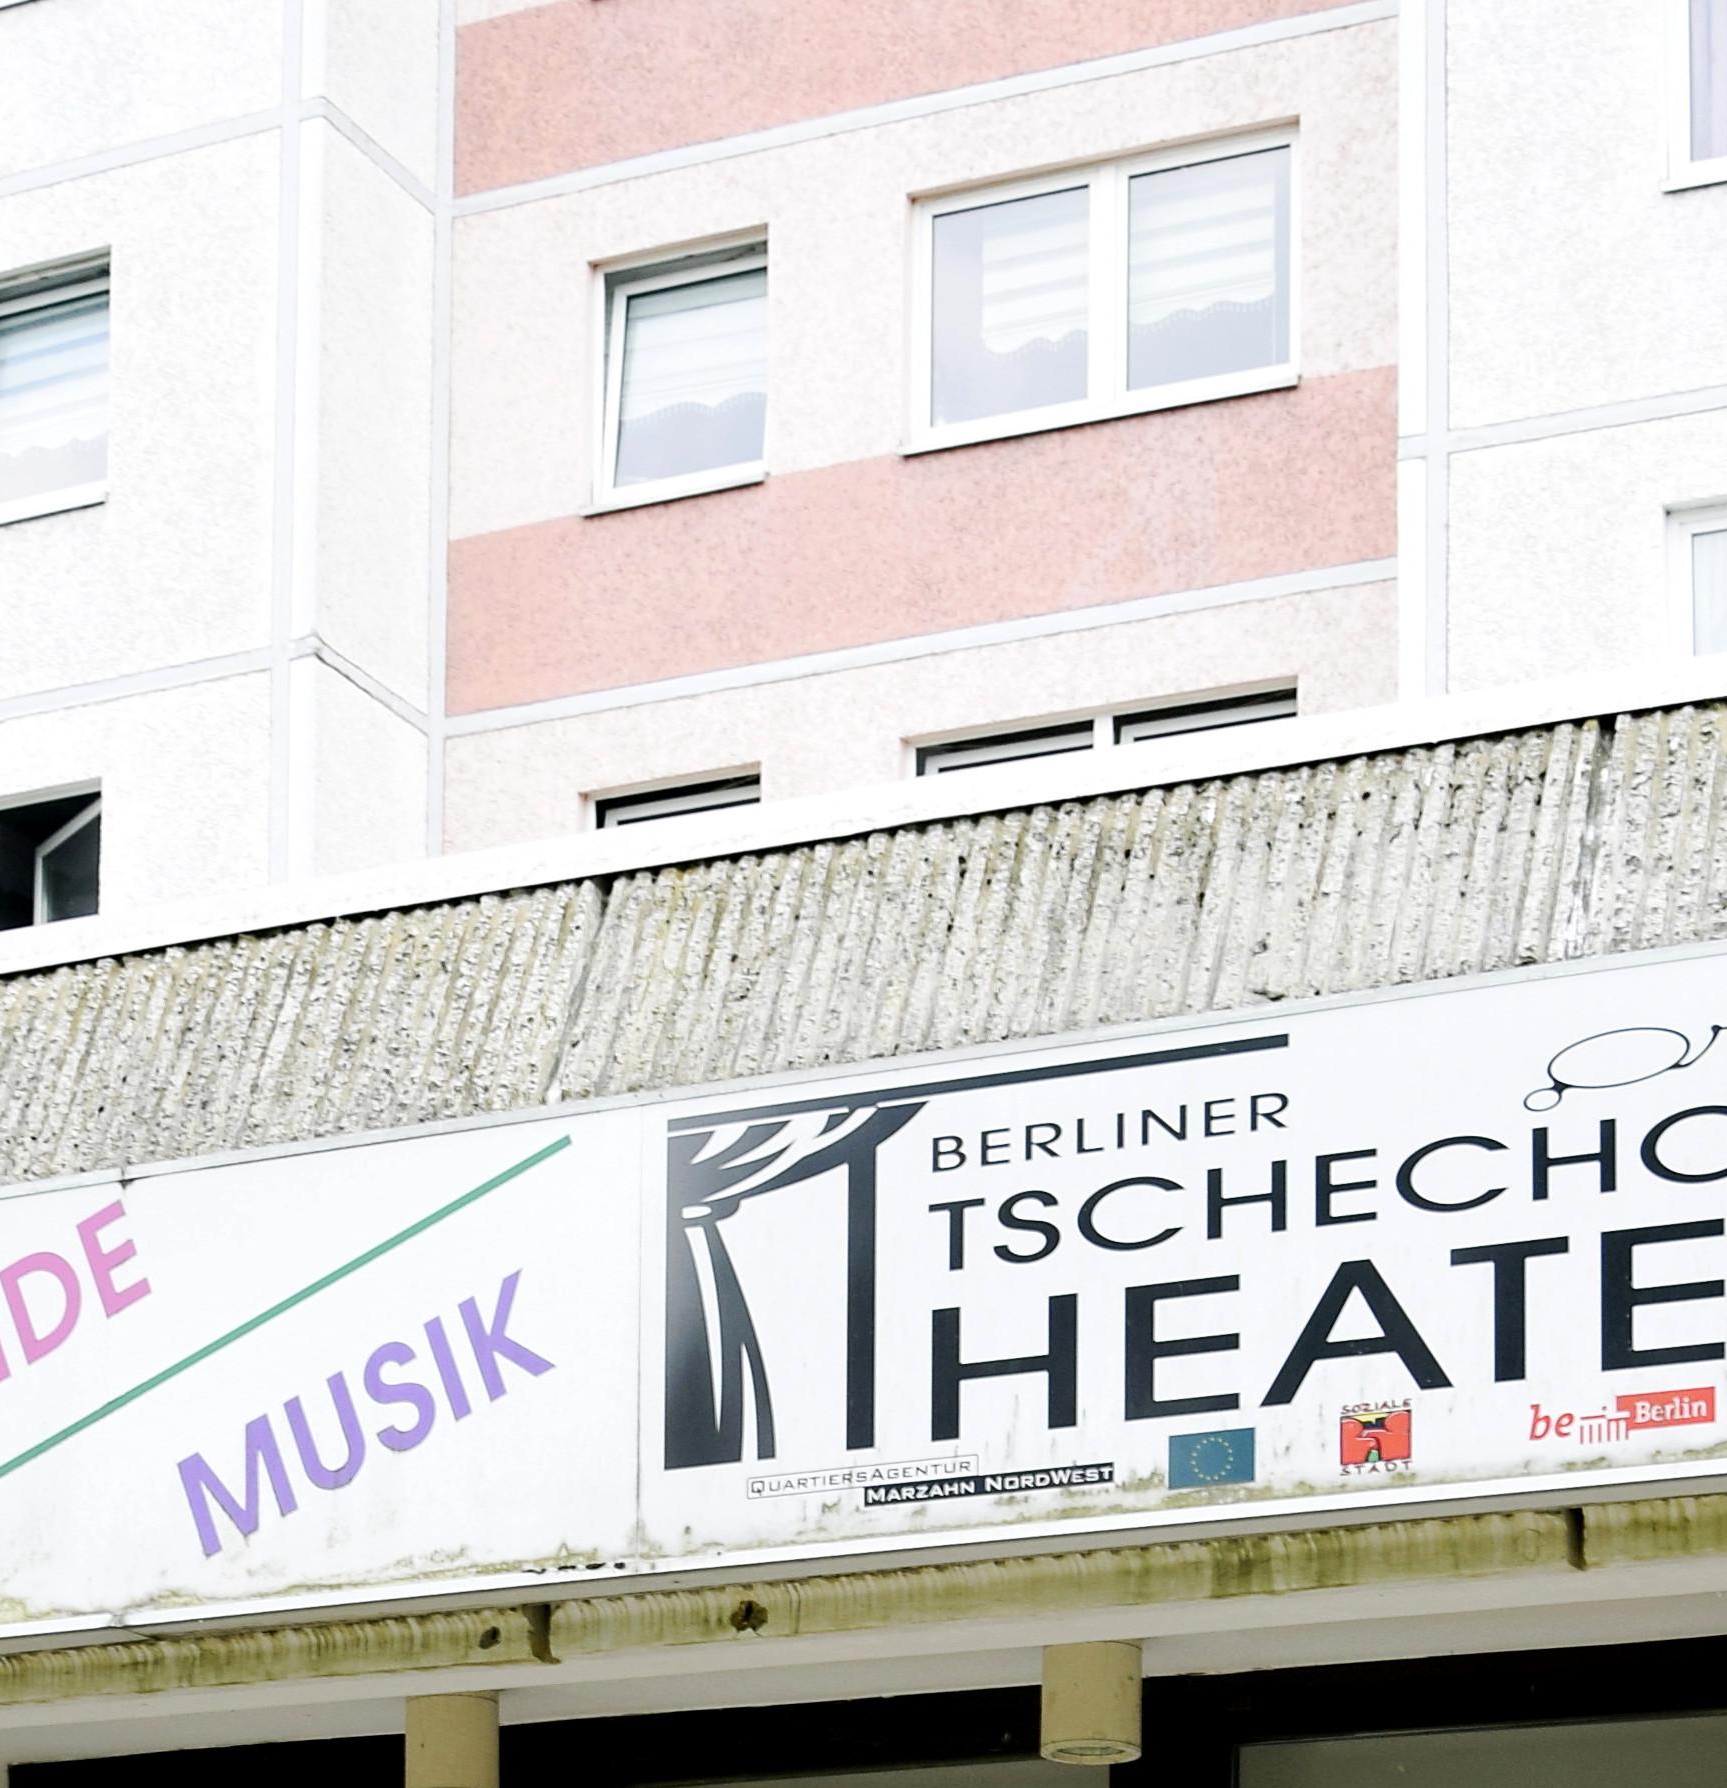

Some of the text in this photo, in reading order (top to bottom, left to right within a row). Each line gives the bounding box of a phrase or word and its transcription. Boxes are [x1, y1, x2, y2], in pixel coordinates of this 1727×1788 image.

[932, 1091, 1289, 1174] BERLINER
[175, 1267, 557, 1558] MUSIK
[1339, 1397, 1412, 1415] SOZIALE
[1634, 1395, 1708, 1424] Berlin
[1338, 1460, 1412, 1477] STADT
